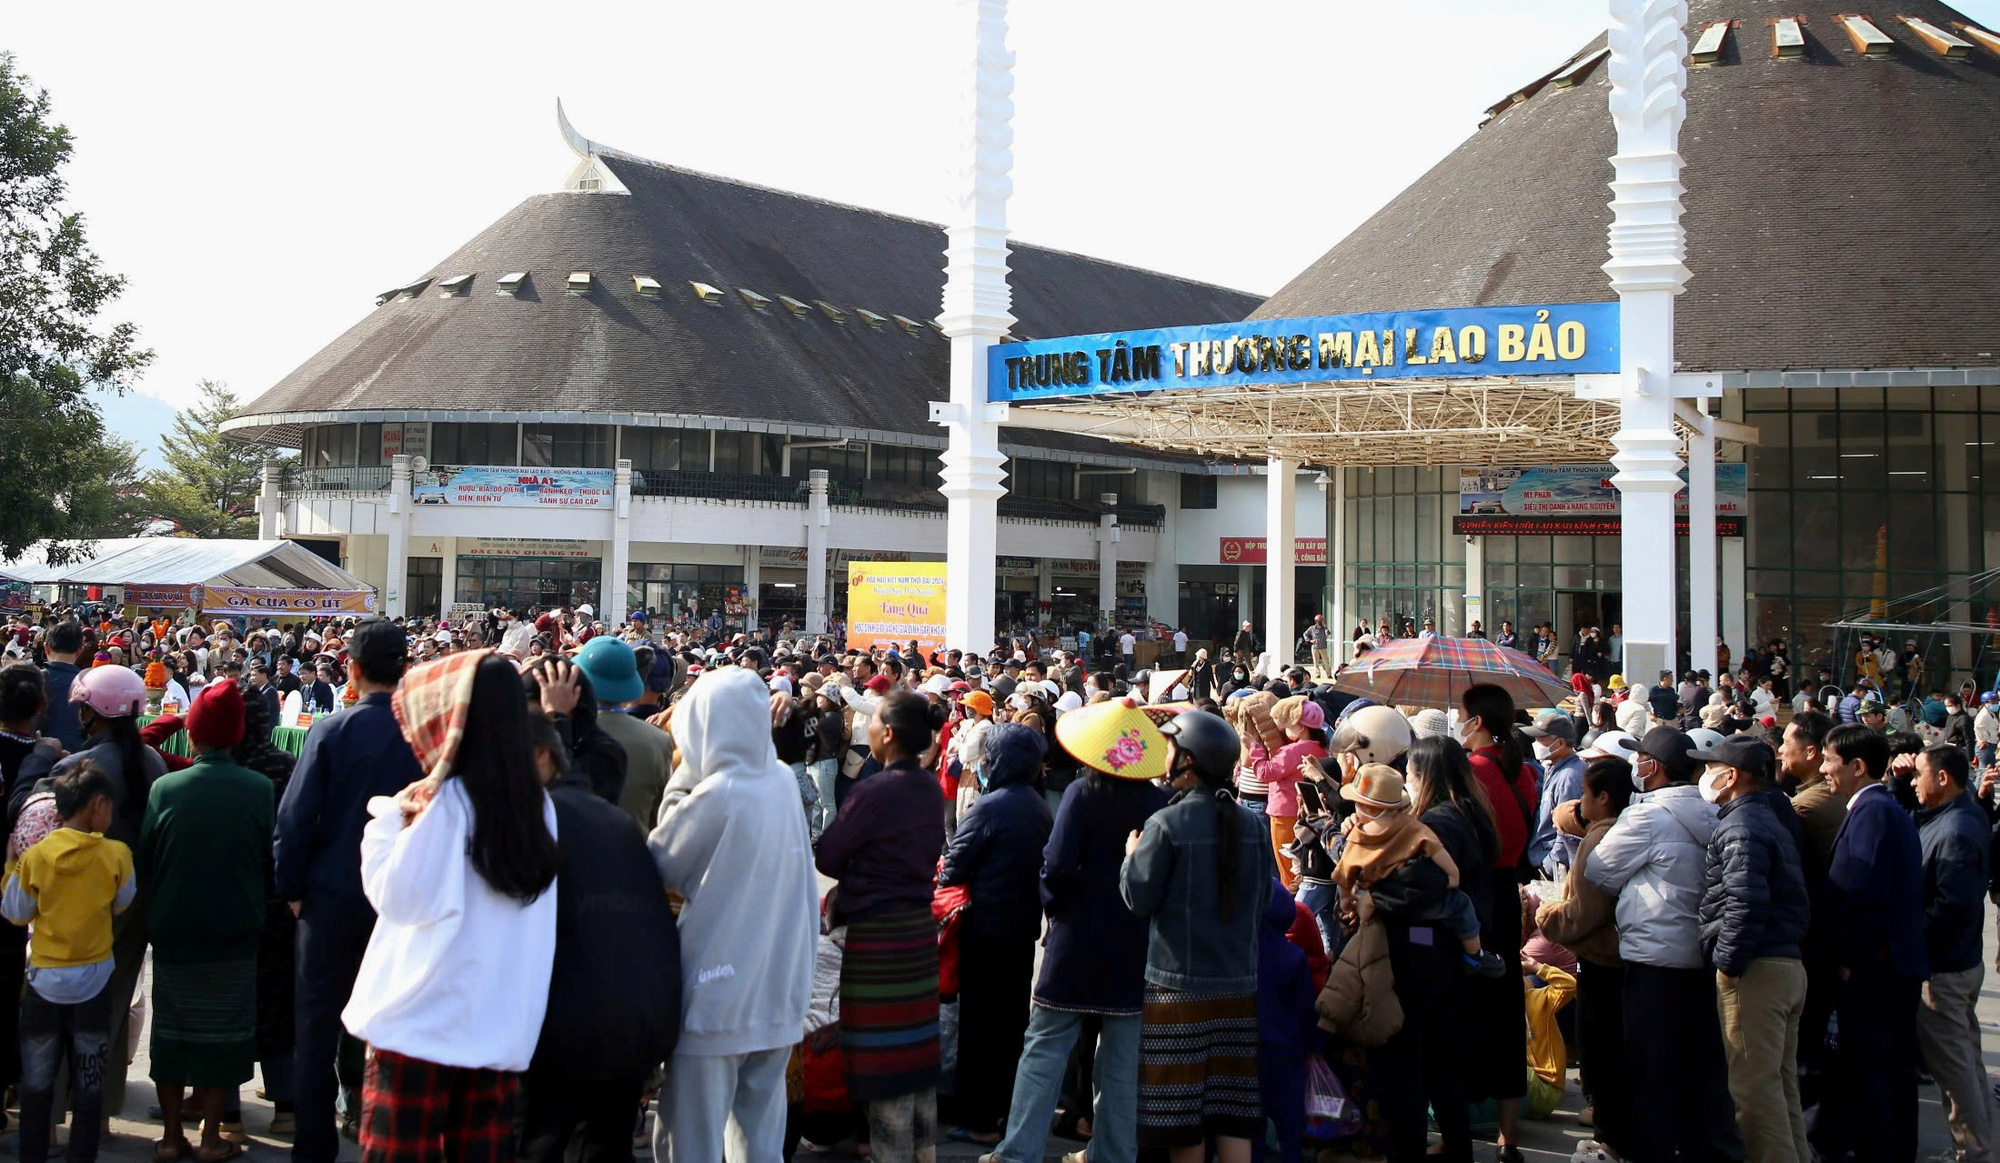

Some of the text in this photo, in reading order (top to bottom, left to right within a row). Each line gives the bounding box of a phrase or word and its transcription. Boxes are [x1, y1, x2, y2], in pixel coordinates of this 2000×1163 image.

[1005, 309, 1586, 390] TRUNG TÂM THƯƠNG MẠI LAO BẢO
